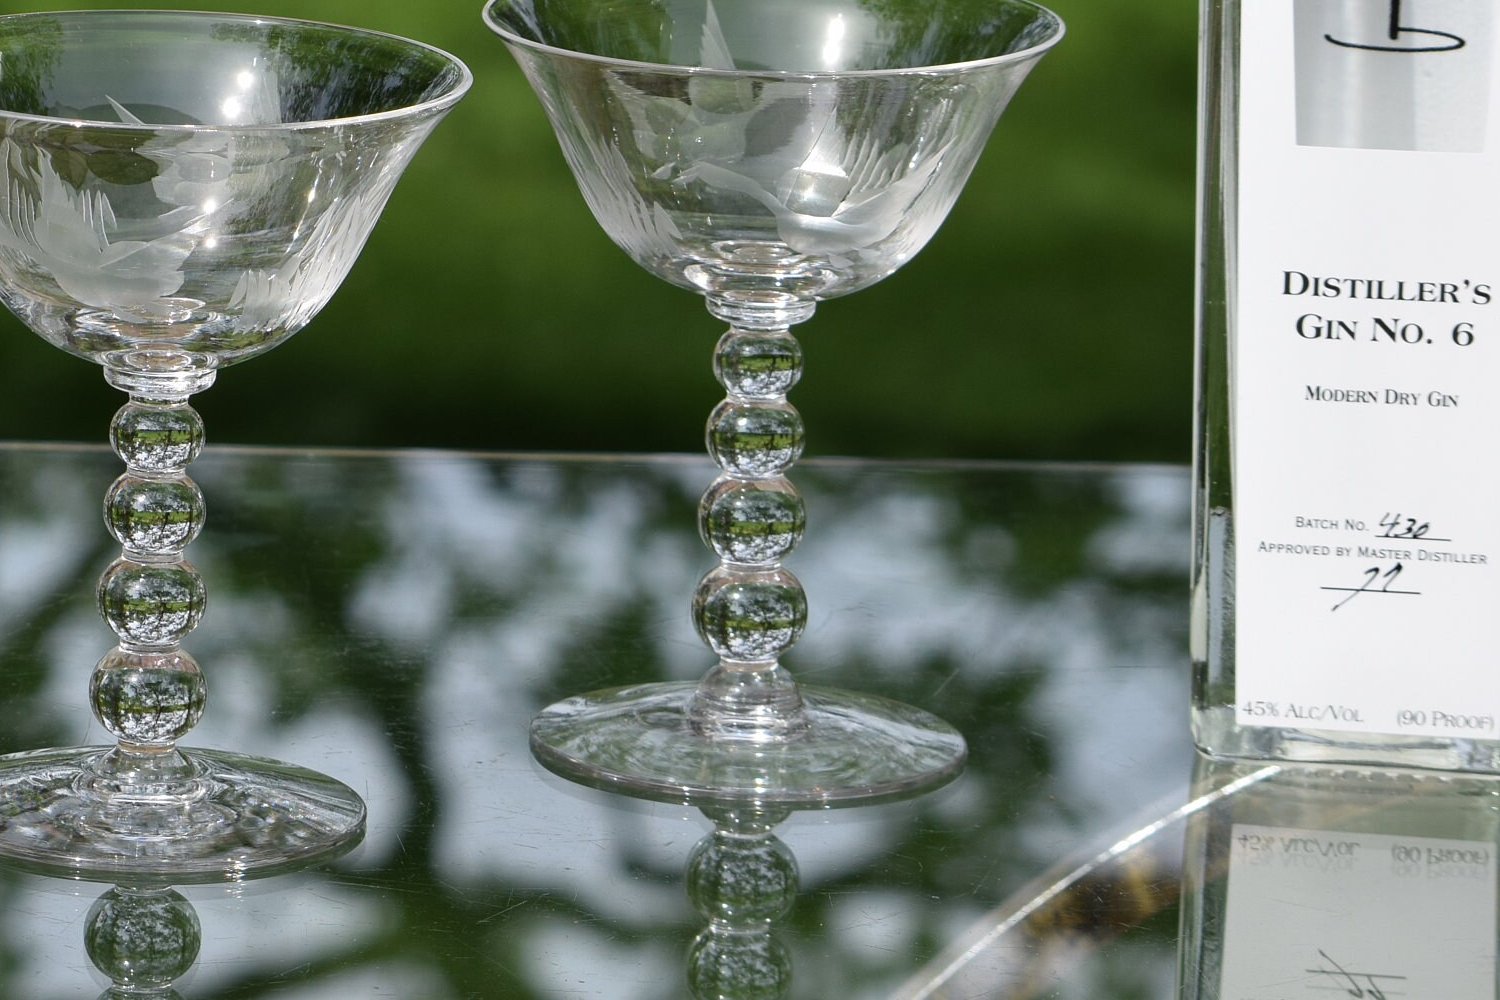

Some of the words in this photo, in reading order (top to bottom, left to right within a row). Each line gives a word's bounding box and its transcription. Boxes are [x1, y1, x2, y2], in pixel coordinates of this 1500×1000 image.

[1281, 270, 1492, 305] DISTILLER'S
[1296, 313, 1359, 341] GIN
[1452, 322, 1475, 347] 6
[1304, 384, 1378, 404] MODERN
[1384, 388, 1421, 406] DRY
[1427, 390, 1460, 408] GIN
[1295, 516, 1339, 531] BATCH
[1257, 540, 1330, 556] APPROVED
[1357, 546, 1412, 561] MASTER
[1417, 549, 1488, 565] DISTILLER
[1242, 701, 1280, 718] 45%
